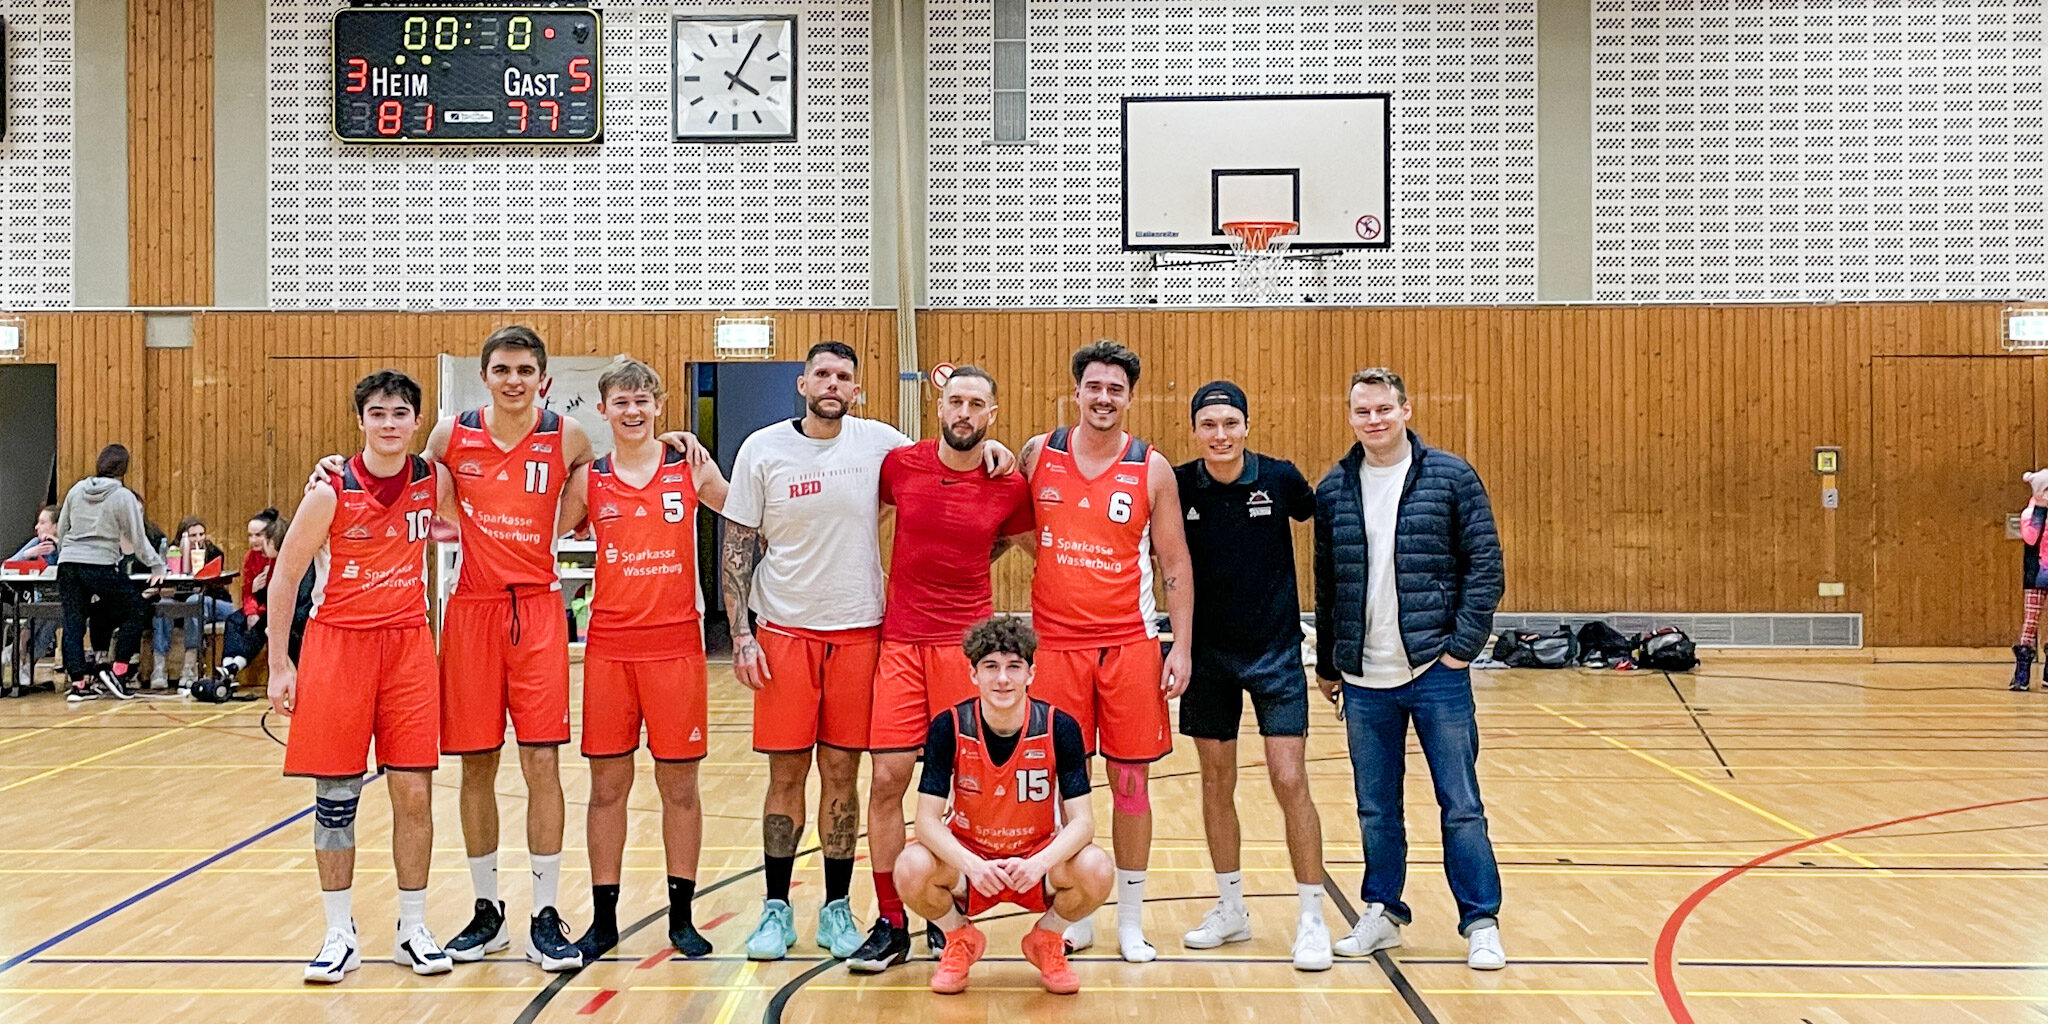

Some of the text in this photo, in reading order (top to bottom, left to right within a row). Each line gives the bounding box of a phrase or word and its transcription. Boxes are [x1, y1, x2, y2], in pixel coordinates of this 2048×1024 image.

[346, 57, 368, 93] 3
[568, 57, 592, 93] 5
[377, 101, 434, 135] 81
[507, 101, 559, 132] 77
[524, 460, 549, 494] 11
[789, 480, 822, 499] RED
[477, 511, 533, 526] Sparkasse
[661, 491, 685, 523] 5
[1108, 490, 1133, 523] 6
[405, 508, 433, 543] 10
[621, 549, 676, 563] Sparkasse
[1057, 538, 1114, 556] Sparkasse
[623, 563, 683, 577] Wasserburg
[1056, 553, 1122, 573] Wasserburg
[1015, 768, 1050, 803] 15
[975, 825, 1035, 837] Sparkasse
